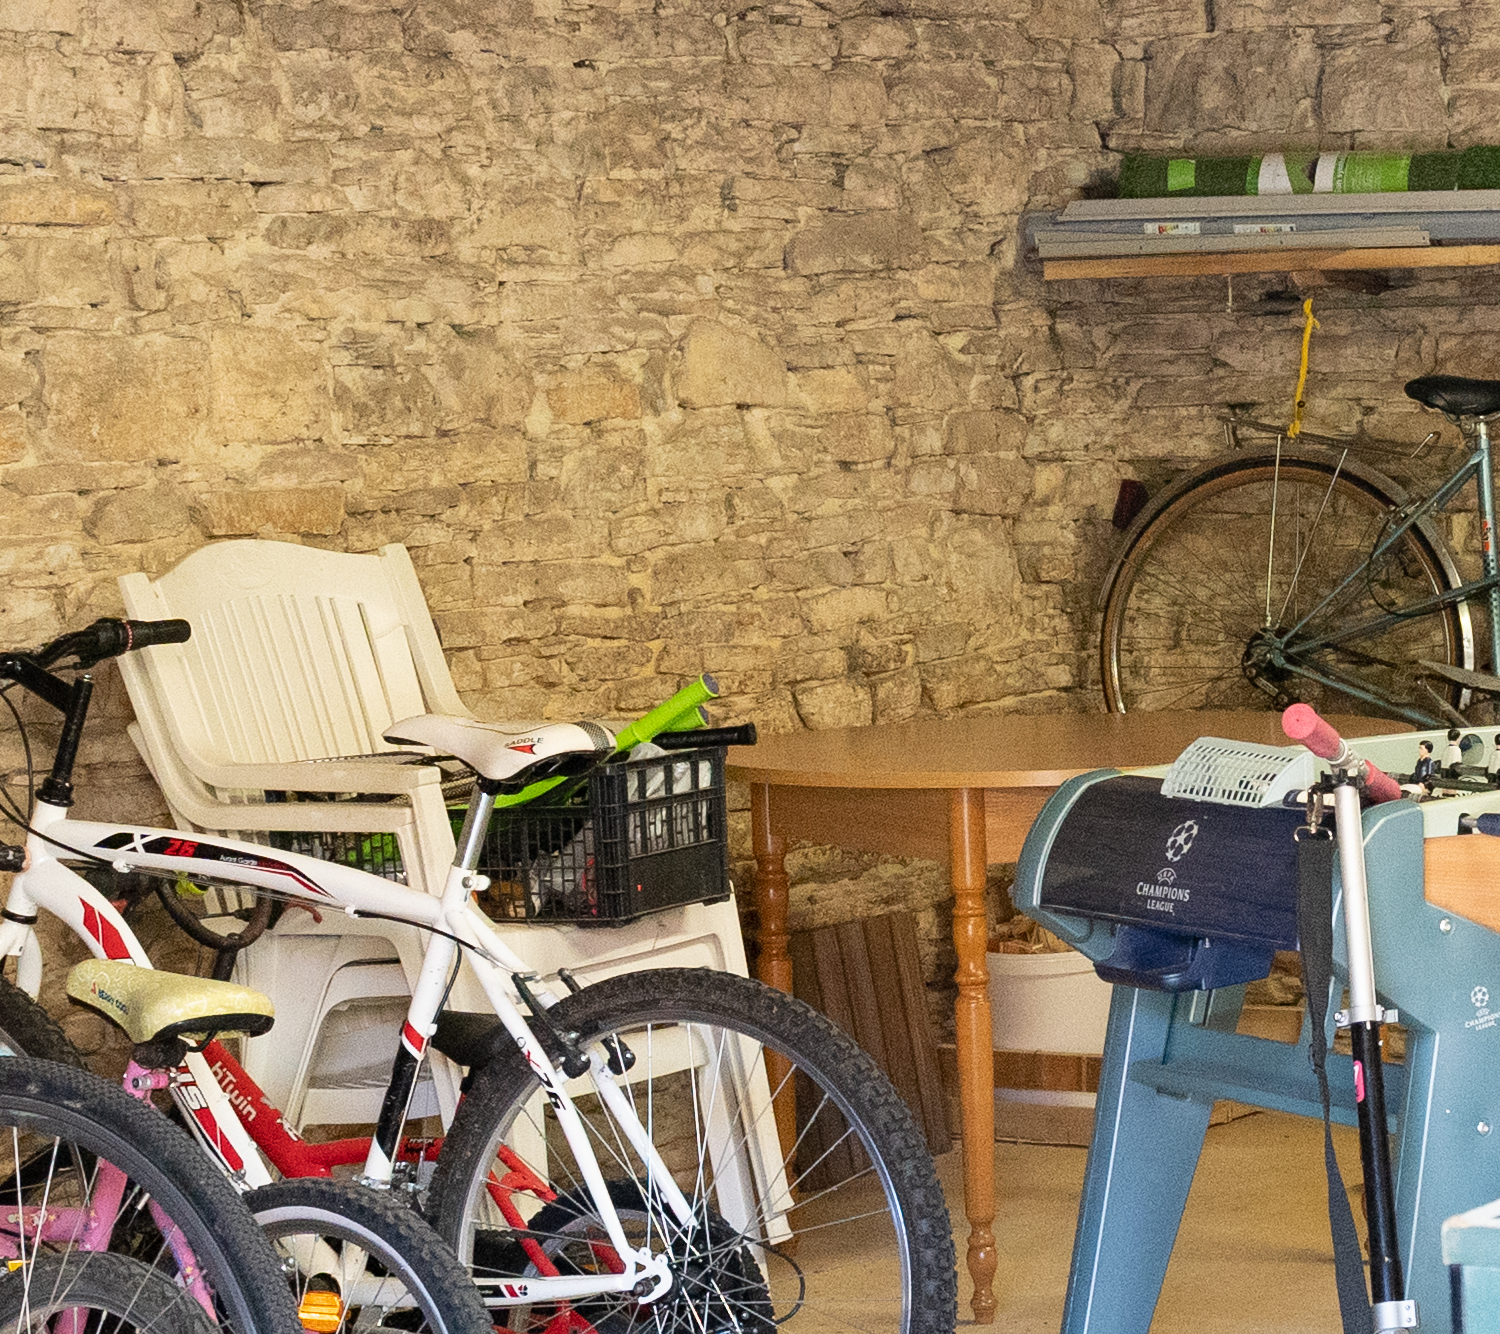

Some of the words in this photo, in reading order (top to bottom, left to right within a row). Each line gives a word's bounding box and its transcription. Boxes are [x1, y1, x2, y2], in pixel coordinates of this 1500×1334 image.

[163, 837, 199, 858] 26
[1136, 882, 1191, 903] CHAMPIONS
[1146, 899, 1175, 914] LEAGUE
